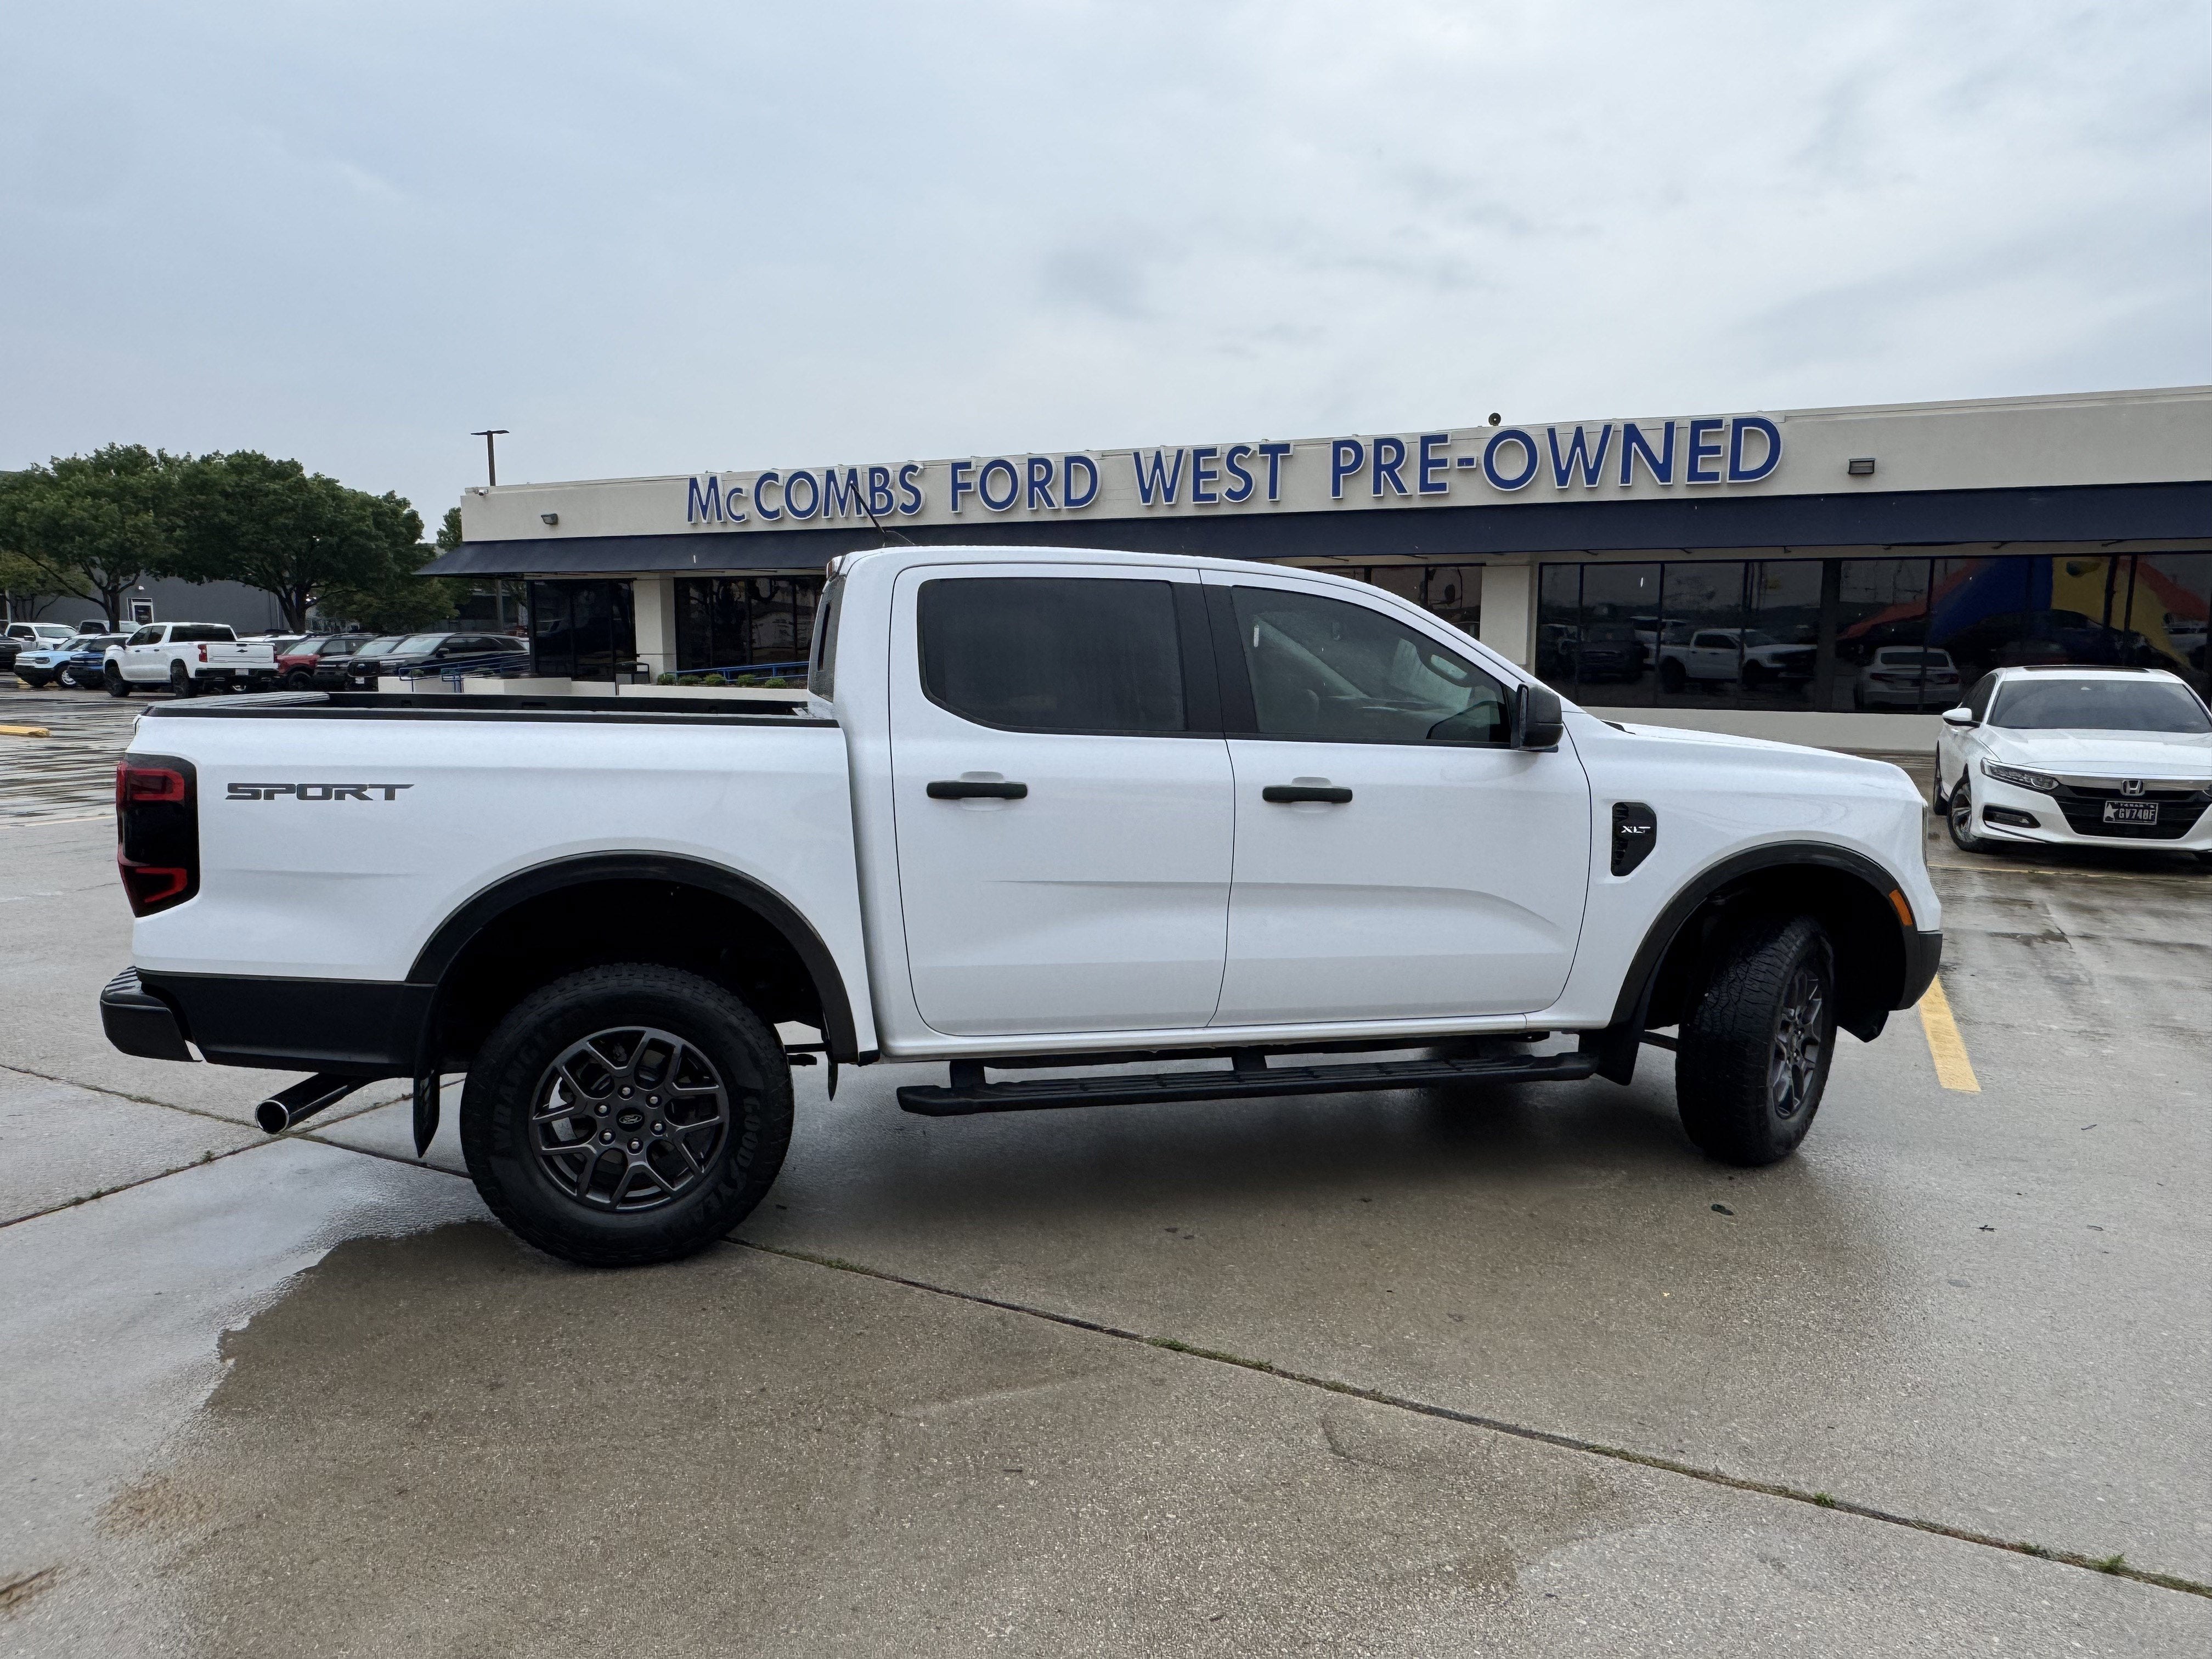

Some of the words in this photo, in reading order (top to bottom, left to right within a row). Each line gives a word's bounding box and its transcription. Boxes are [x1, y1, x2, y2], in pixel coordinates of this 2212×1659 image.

[687, 462, 926, 524] McCOMBS
[950, 455, 1101, 514] FORD
[1132, 442, 1294, 506] WEST
[1330, 415, 1784, 499] PRE-OWNED
[225, 783, 415, 800] SPORT
[1621, 825, 1651, 833] XLT
